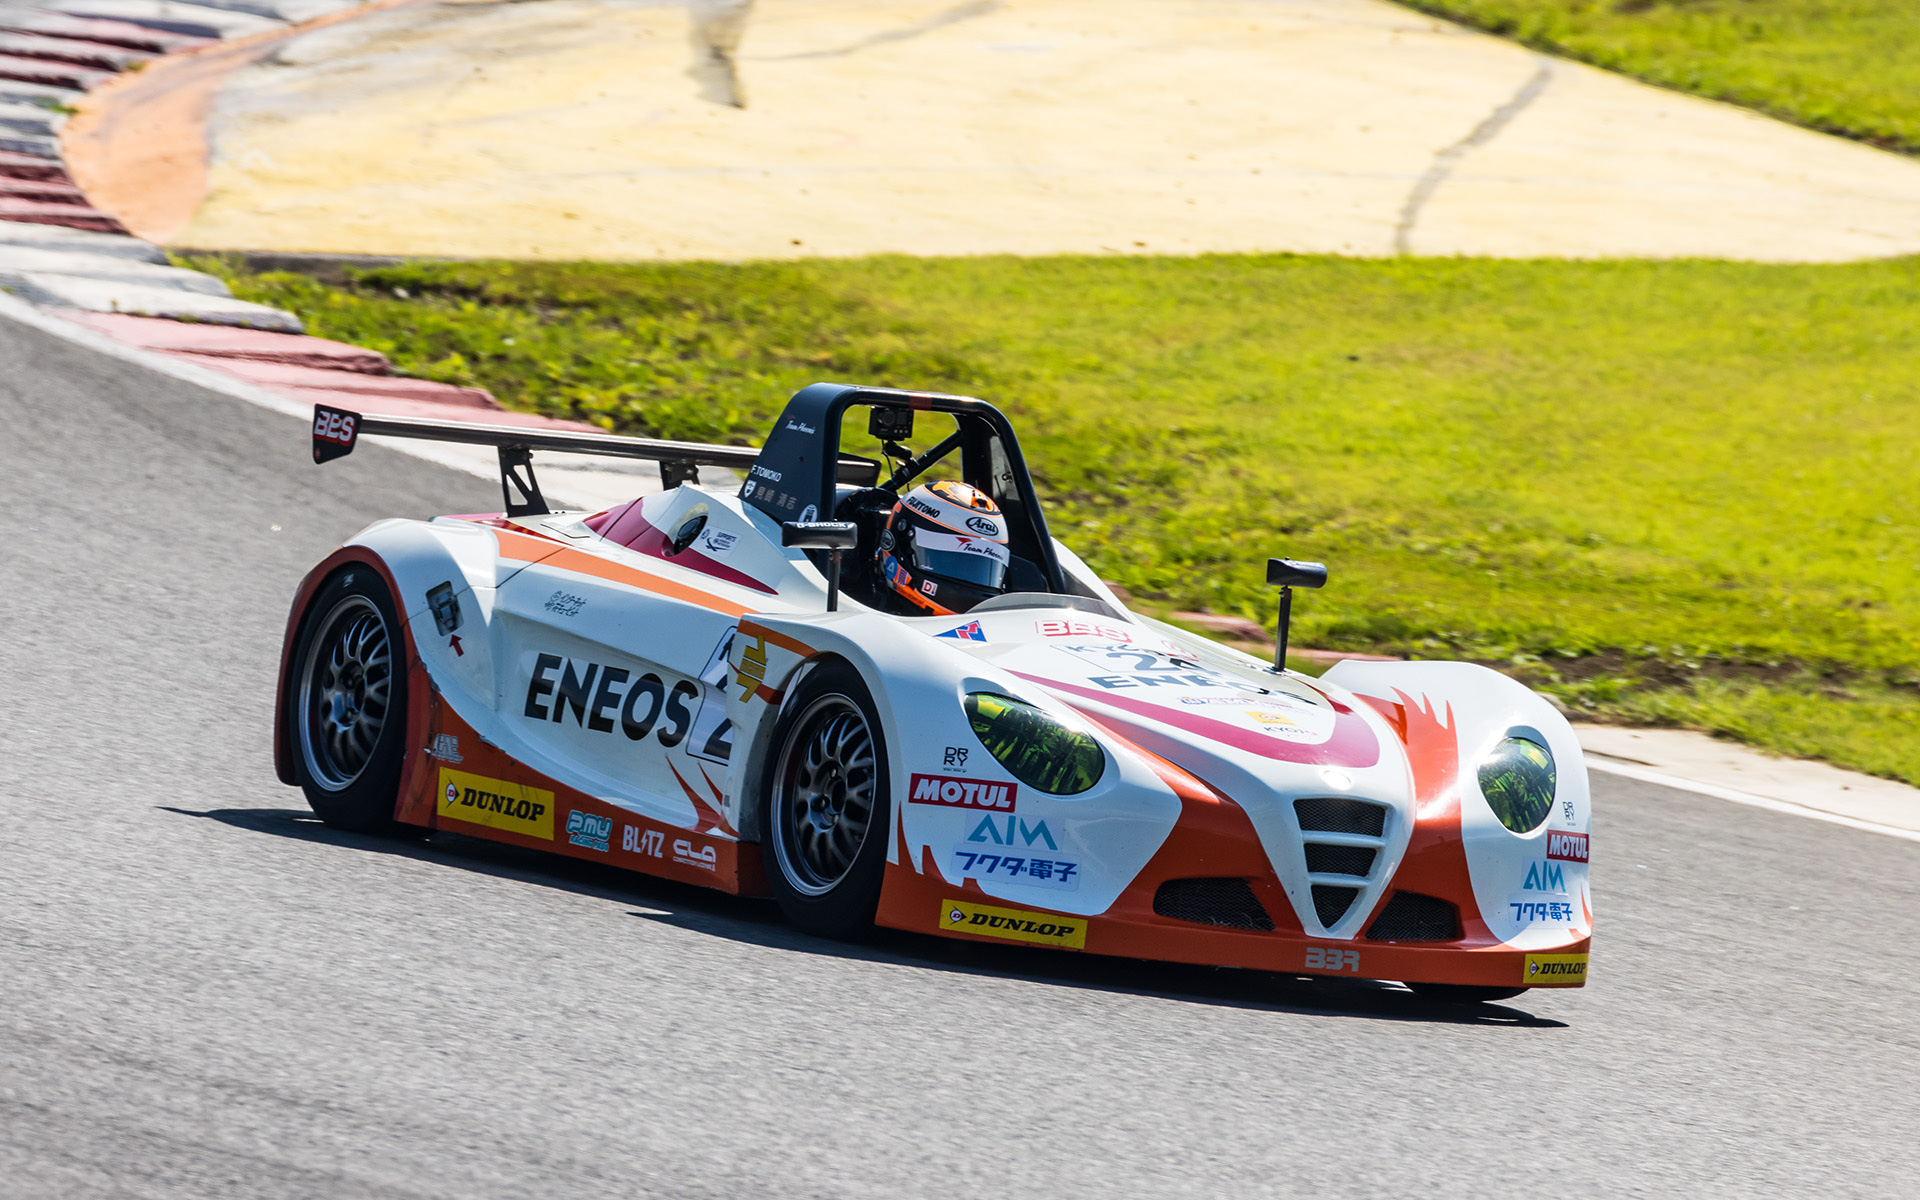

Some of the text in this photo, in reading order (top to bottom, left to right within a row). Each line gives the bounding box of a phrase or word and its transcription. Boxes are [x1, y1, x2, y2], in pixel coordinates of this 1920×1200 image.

[750, 464, 782, 483] F.TOMOKO
[906, 496, 940, 519] FUJITOMO
[973, 517, 995, 533] Arai
[963, 542, 982, 554] Team
[1036, 620, 1133, 643] BBS
[524, 652, 699, 748] ENEOS
[460, 787, 545, 821] DUNLOP
[913, 778, 1011, 808] MOTUL
[622, 825, 665, 858] BLITZ
[967, 813, 1058, 851] AIM
[1549, 834, 1588, 859] MOTUL
[955, 851, 1078, 882] フクダ電子
[1523, 860, 1566, 892] AIM
[1510, 902, 1573, 922] フクダ電子
[968, 913, 1075, 937] DUNLOP
[1540, 962, 1587, 975] DUNLOP
